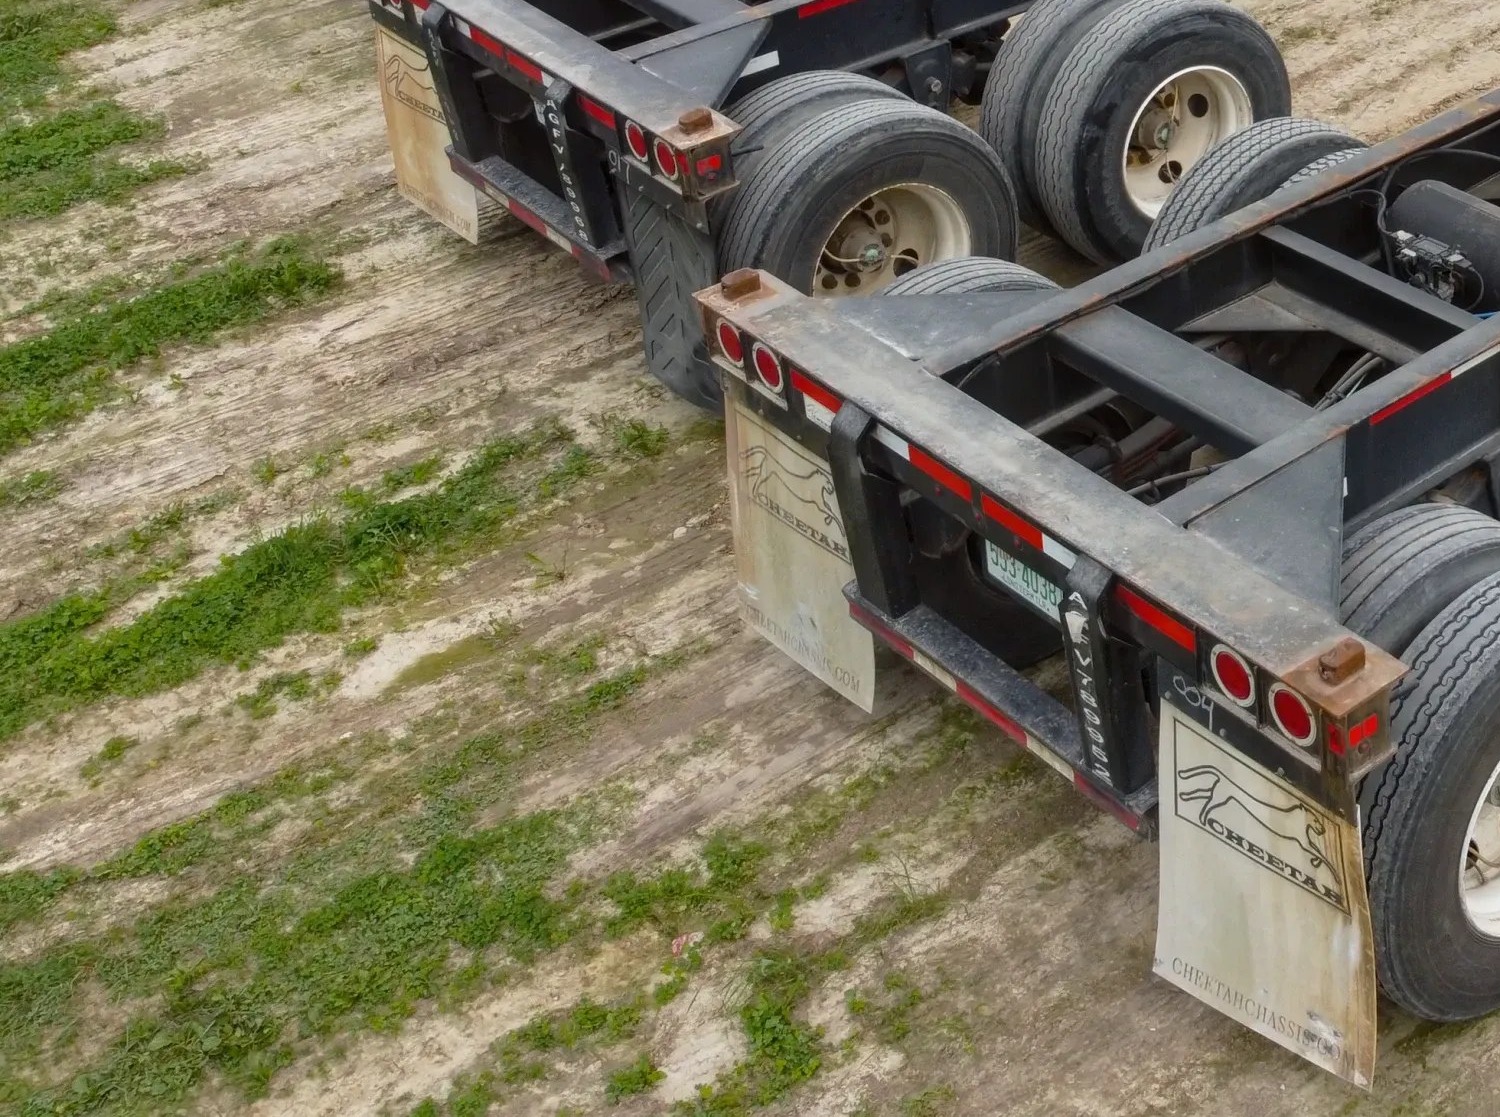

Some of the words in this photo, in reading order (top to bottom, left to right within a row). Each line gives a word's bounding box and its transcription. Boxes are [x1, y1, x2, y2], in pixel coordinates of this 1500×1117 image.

[398, 90, 446, 122] CHEETA
[757, 492, 850, 561] CHEETAH
[1064, 591, 1114, 787] AV789952
[1207, 817, 1347, 911] CHEETAH
[1171, 957, 1356, 1071] CHEETAHCHASSIS.COM
